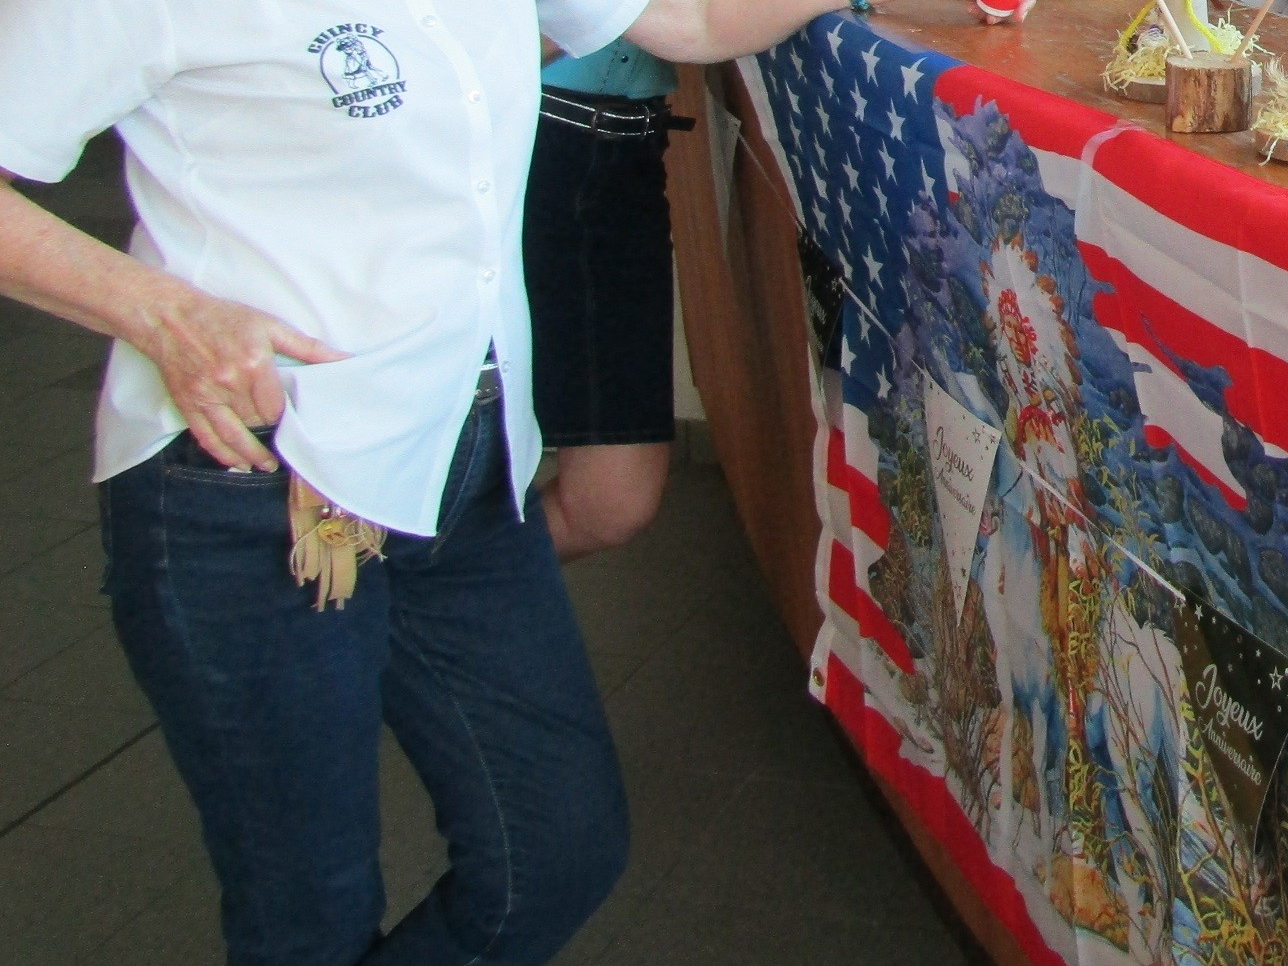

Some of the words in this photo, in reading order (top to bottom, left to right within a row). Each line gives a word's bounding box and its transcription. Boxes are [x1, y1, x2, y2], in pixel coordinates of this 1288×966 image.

[332, 80, 407, 108] COUNTRY
[348, 94, 404, 118] CLUB
[933, 426, 974, 481] Joyeux
[1195, 663, 1263, 741] Joyeux
[1200, 717, 1262, 785] Anniversaire
